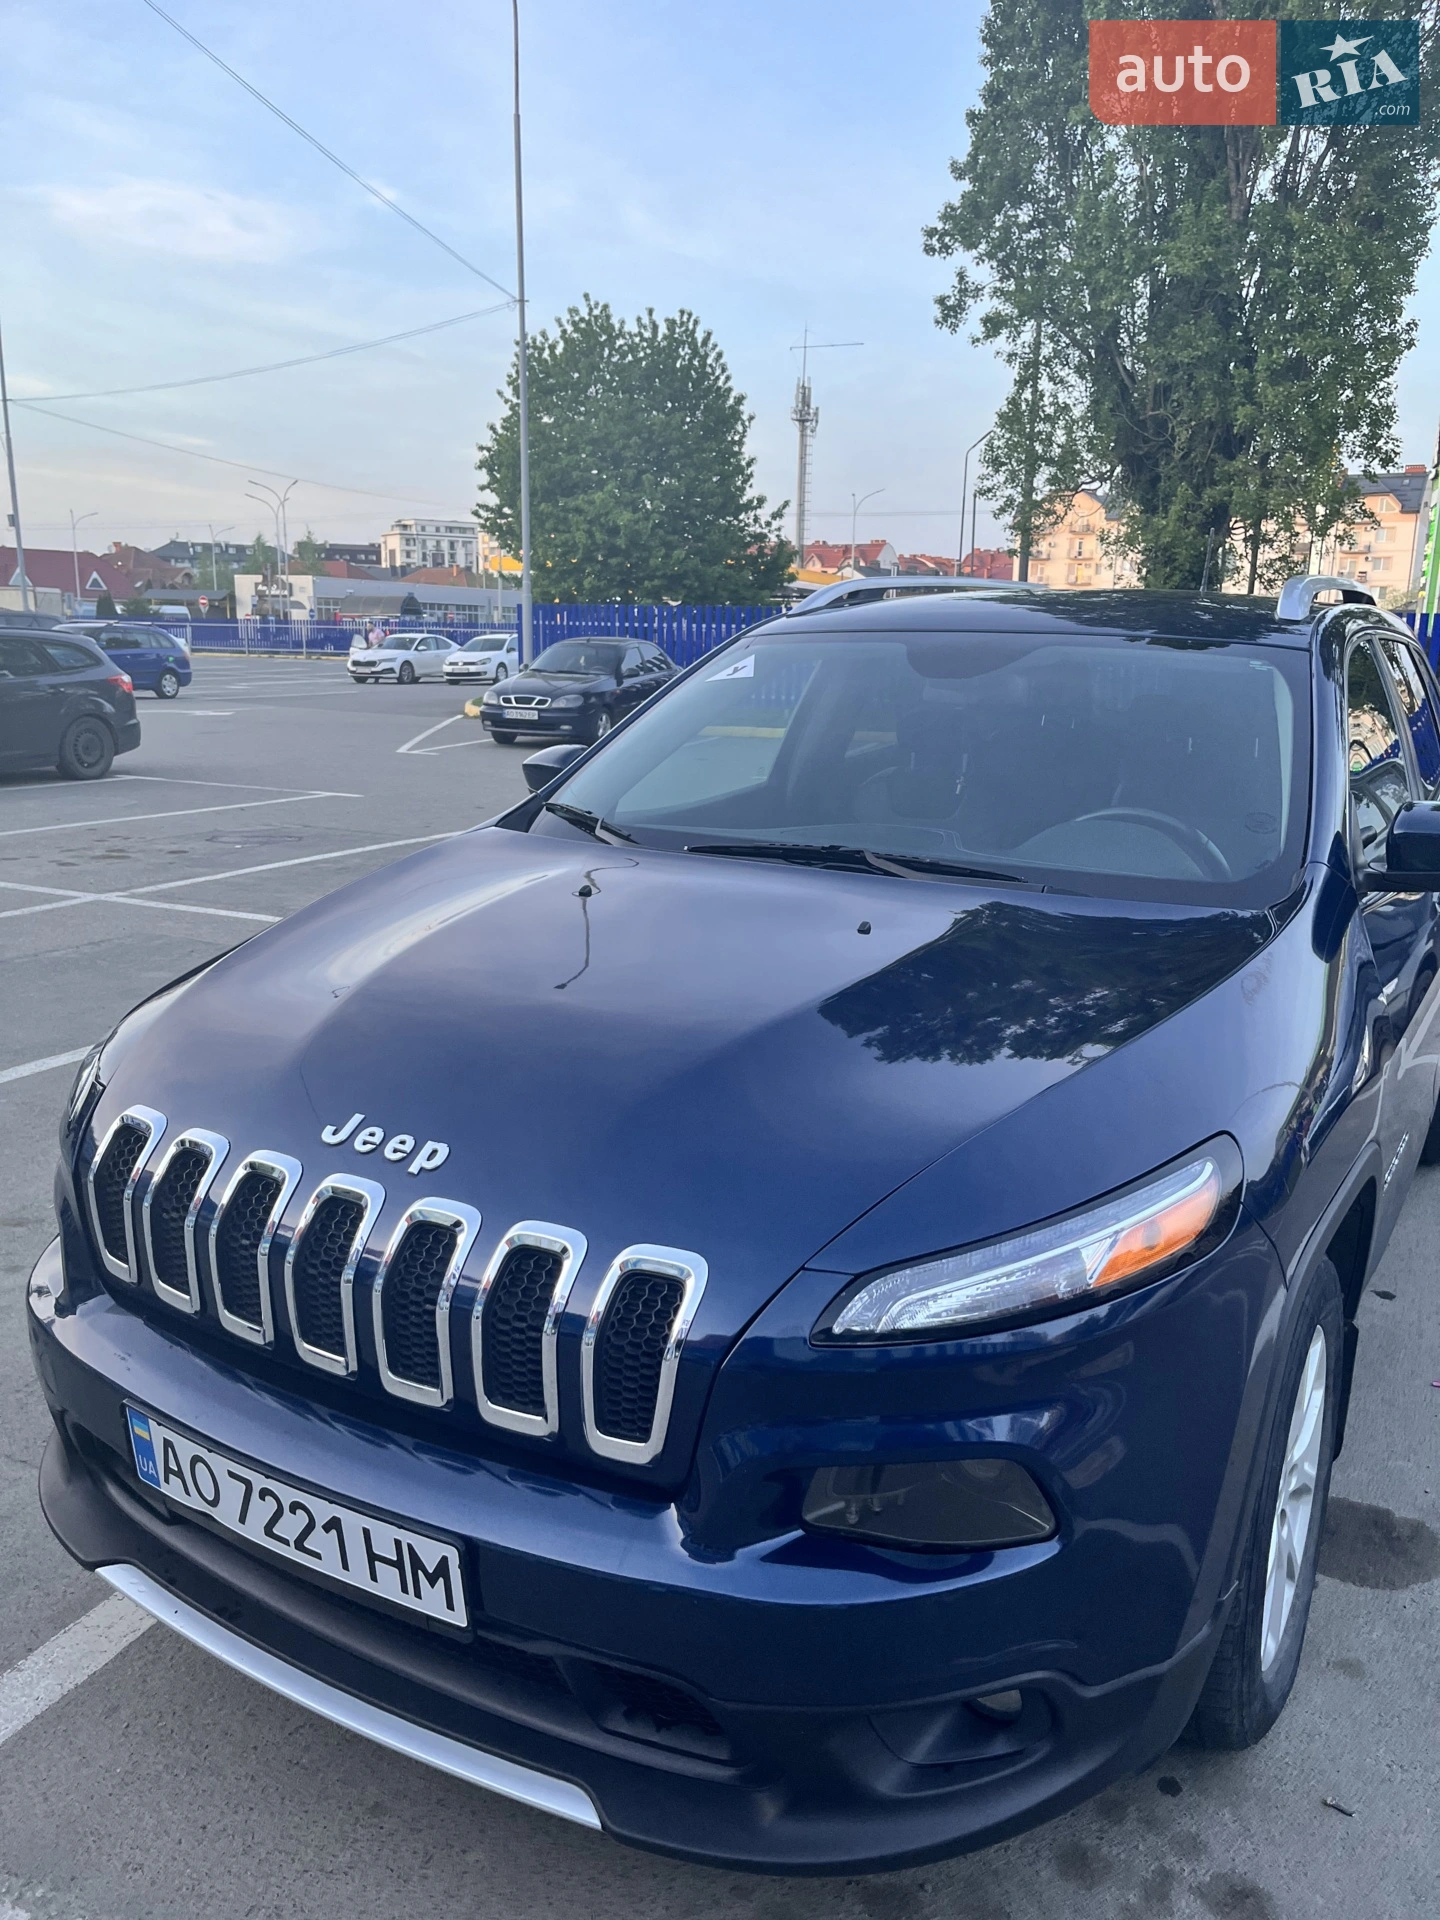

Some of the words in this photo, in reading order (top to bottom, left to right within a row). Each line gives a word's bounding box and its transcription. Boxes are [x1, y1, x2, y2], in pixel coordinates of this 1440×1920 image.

[321, 1113, 450, 1175] Jeep
[138, 1454, 158, 1479] UA
[163, 1436, 220, 1508] AO
[227, 1469, 350, 1572] 7221
[362, 1525, 456, 1613] HM
